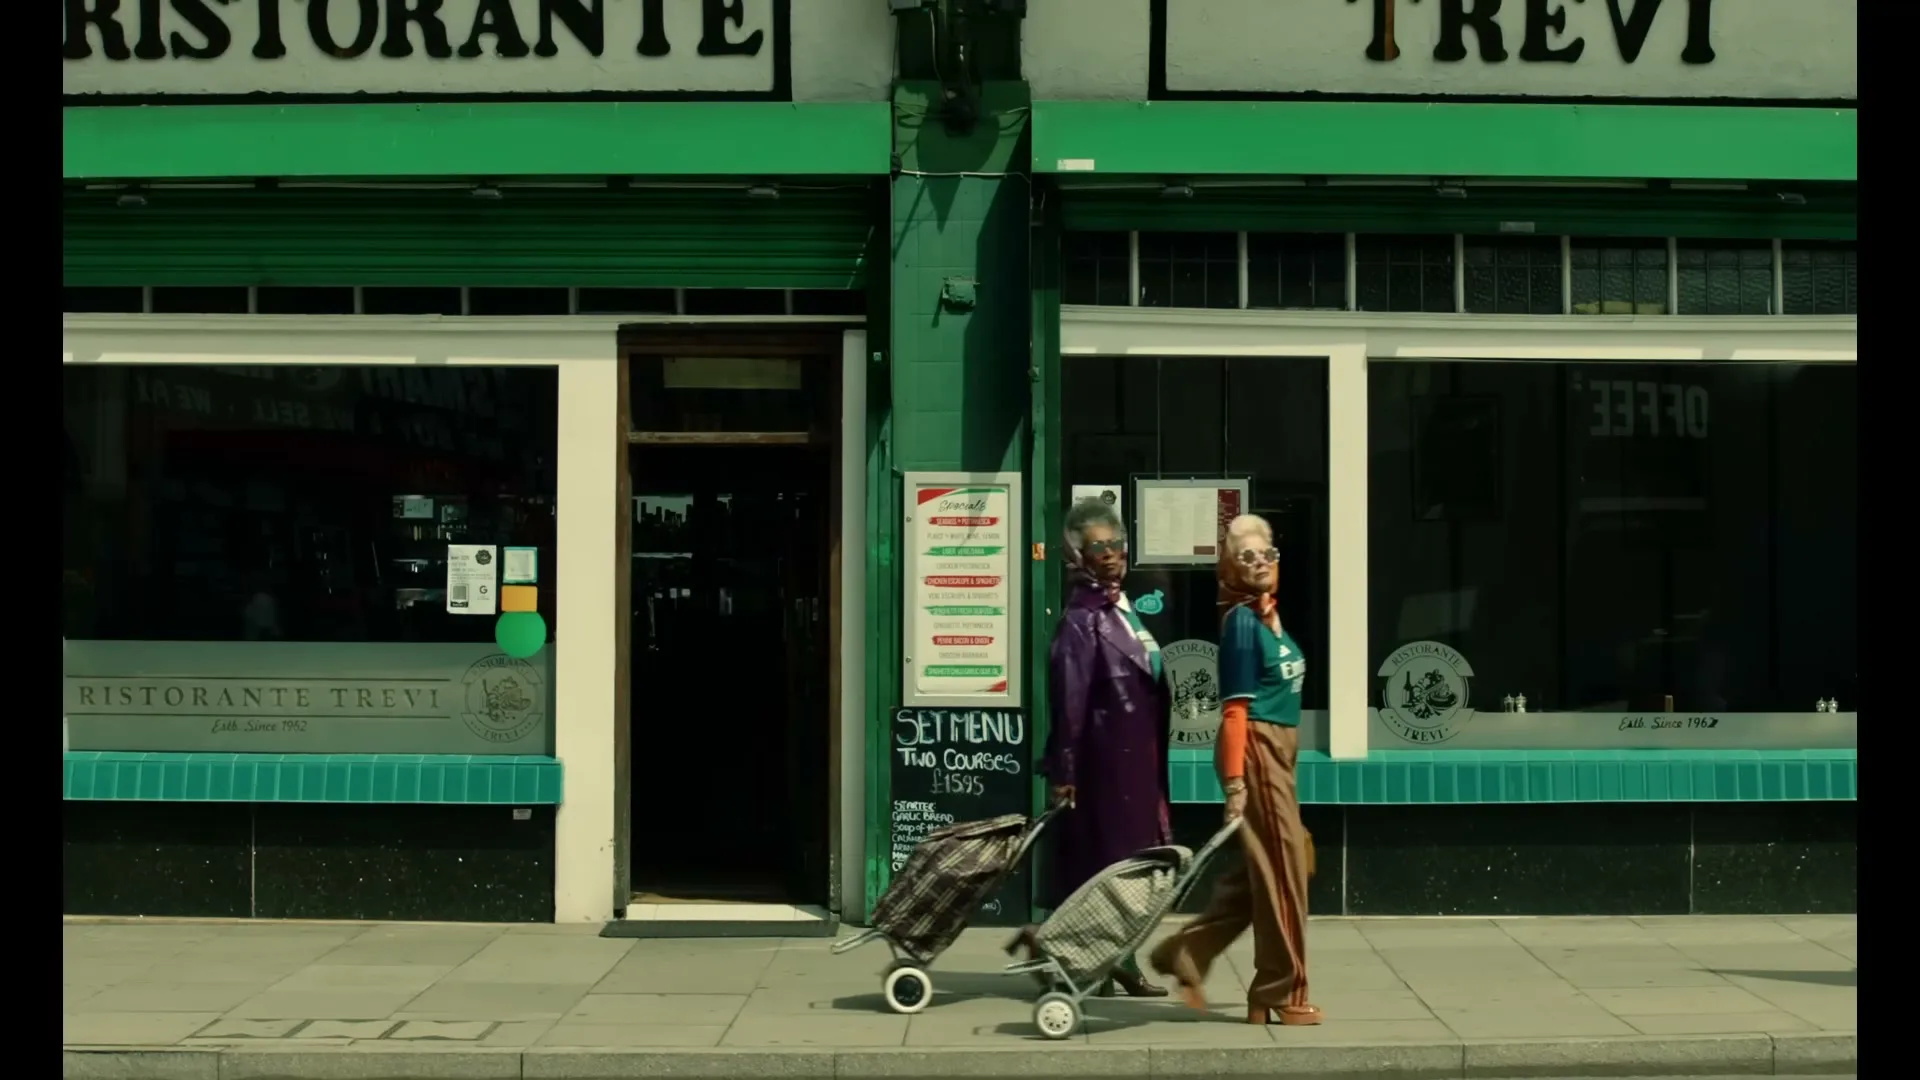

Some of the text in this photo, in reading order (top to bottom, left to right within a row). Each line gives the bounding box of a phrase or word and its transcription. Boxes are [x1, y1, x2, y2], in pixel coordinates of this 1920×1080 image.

[63, 0, 764, 60] RISTORANTE
[1354, 0, 1717, 63] TREVI
[1391, 644, 1463, 668] RISTORANTE
[79, 686, 441, 709] RISTORANTE TREVI
[244, 719, 277, 732] Since
[896, 709, 1024, 746] SET MENU
[1403, 726, 1444, 742] TREVI
[1651, 716, 1683, 729] Since
